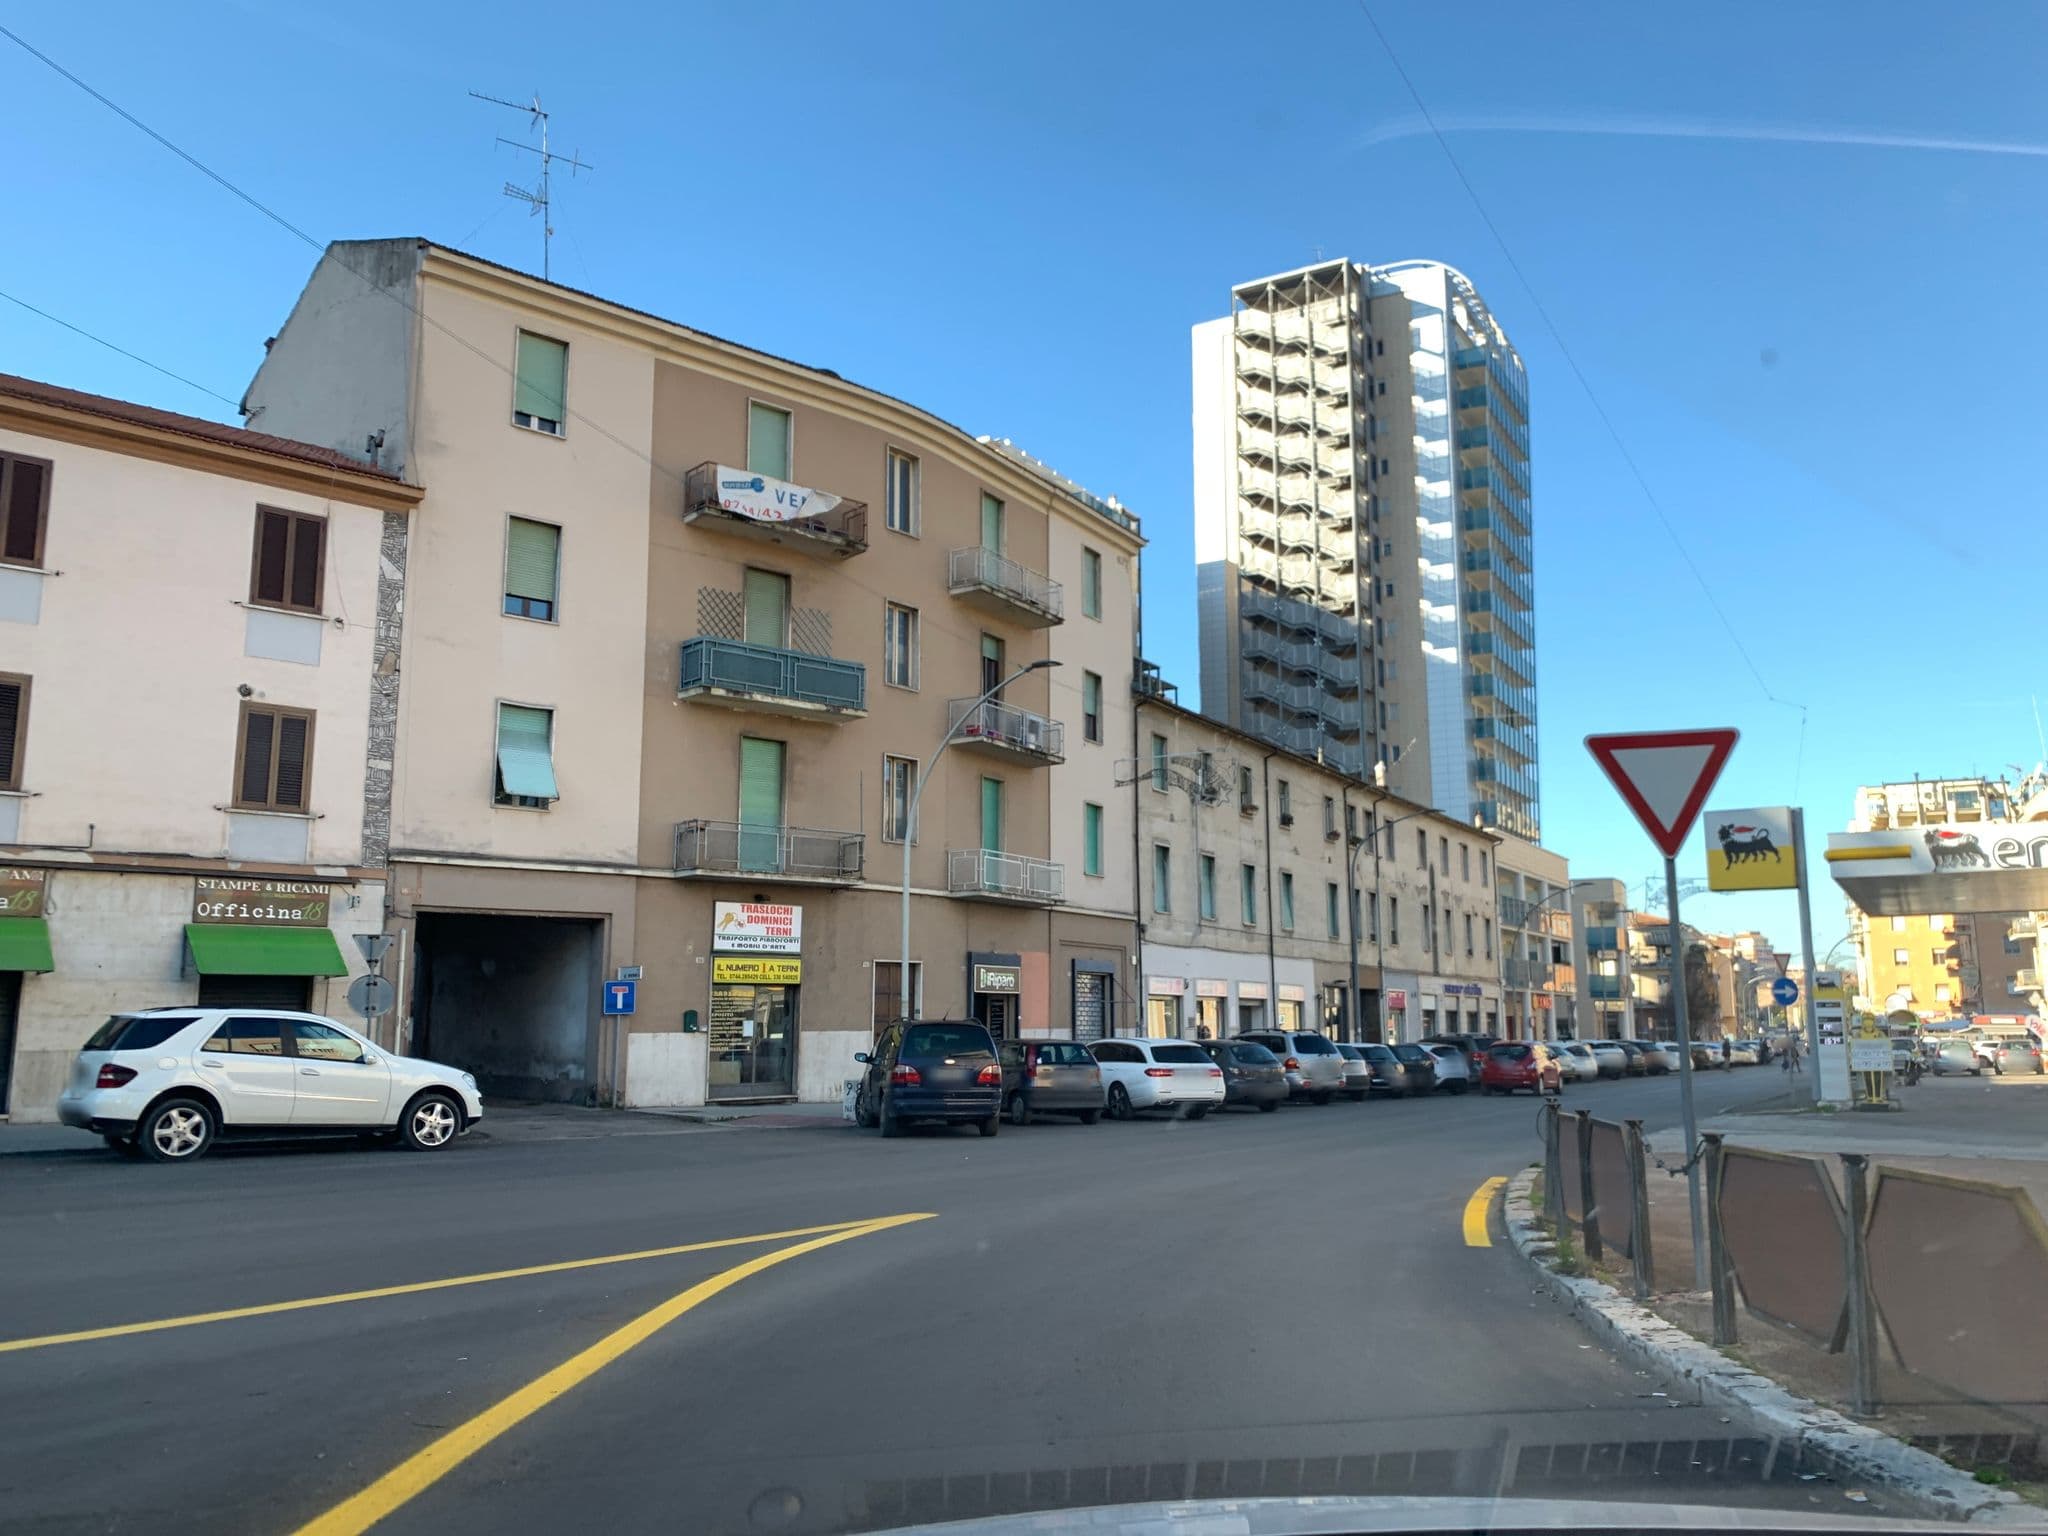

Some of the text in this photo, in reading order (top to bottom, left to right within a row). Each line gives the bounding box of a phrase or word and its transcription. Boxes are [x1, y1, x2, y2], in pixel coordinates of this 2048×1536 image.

[197, 880, 261, 891] STAMPE
[265, 883, 272, 891] &
[276, 883, 329, 894] RICAMI
[740, 904, 793, 915] TRASLOCHI
[747, 915, 793, 926] DOMINICI
[765, 926, 792, 936] TERNI
[726, 964, 759, 972] NUMERO
